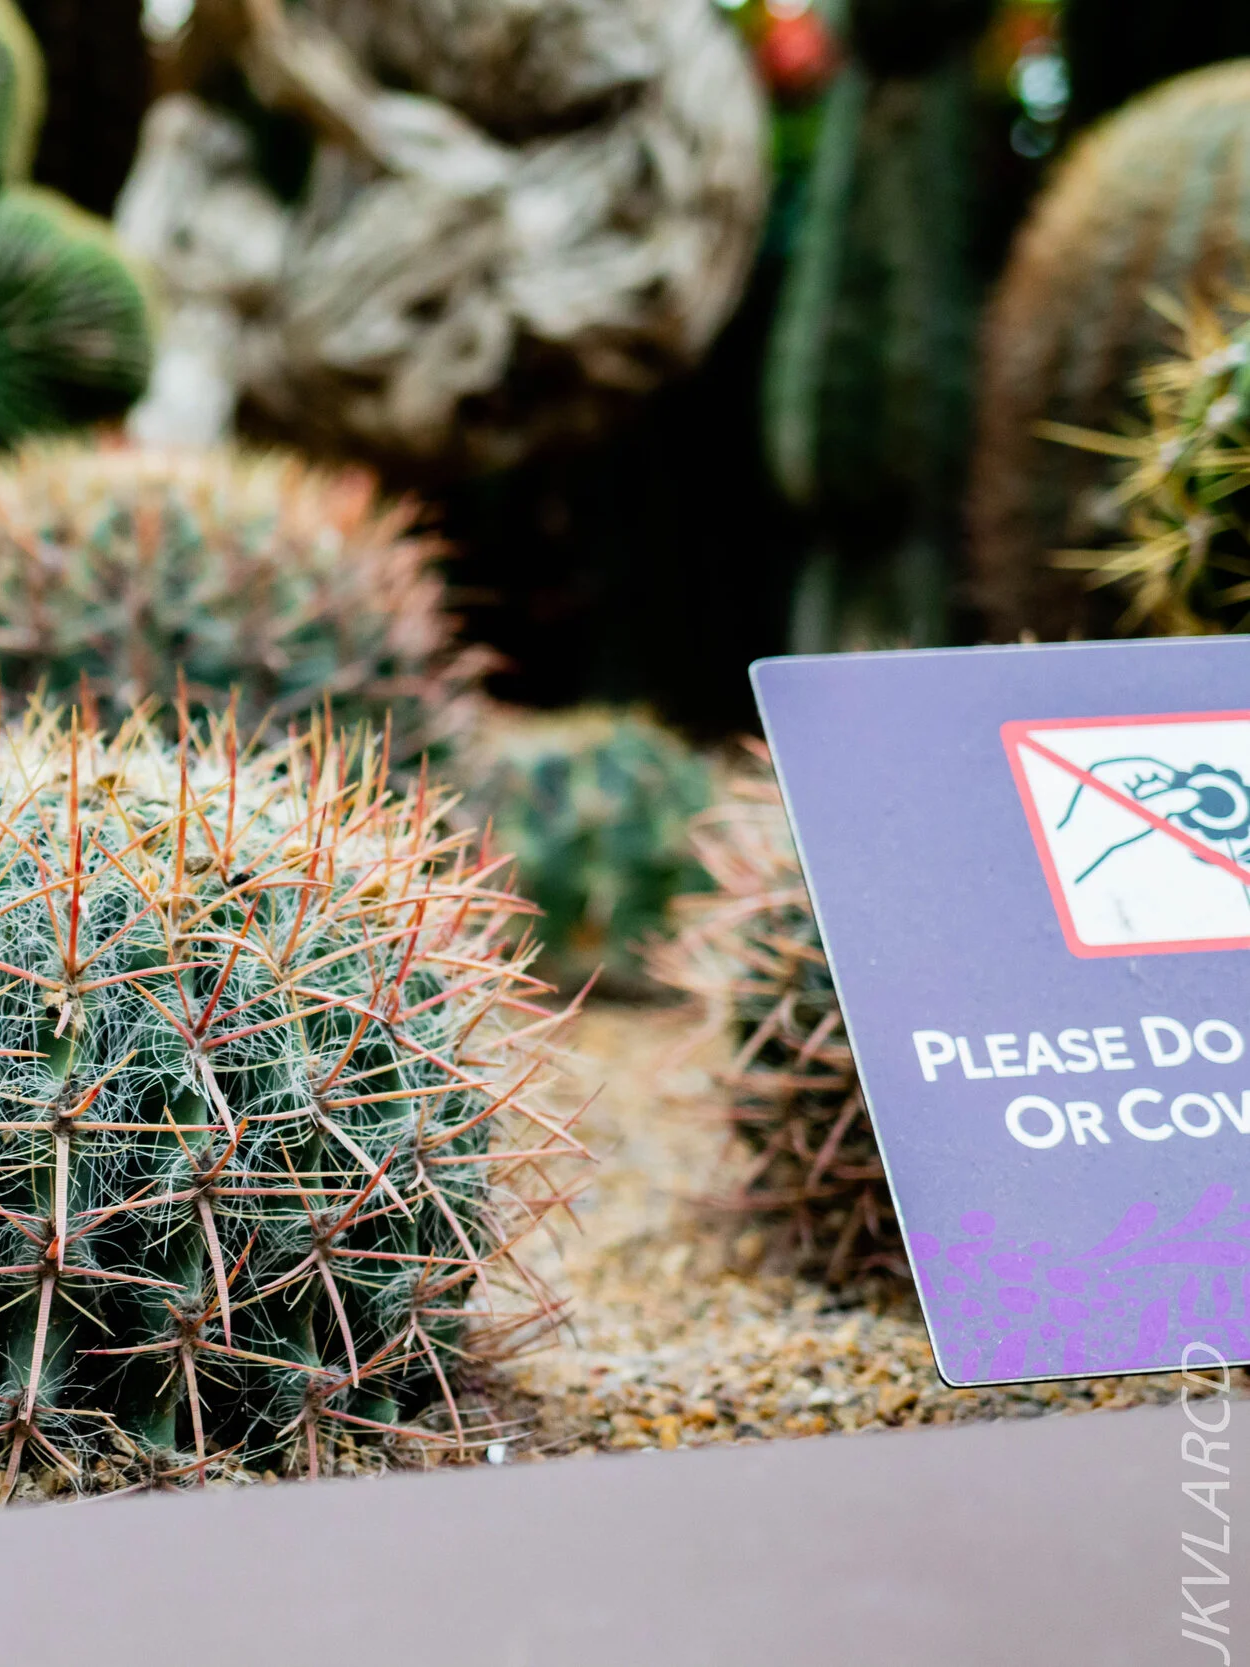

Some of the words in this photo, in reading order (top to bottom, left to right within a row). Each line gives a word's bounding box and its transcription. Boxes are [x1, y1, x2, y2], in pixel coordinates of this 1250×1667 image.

[912, 1027, 1135, 1082] PLEASE
[1140, 1015, 1244, 1068] DO
[1004, 1094, 1111, 1149] OR
